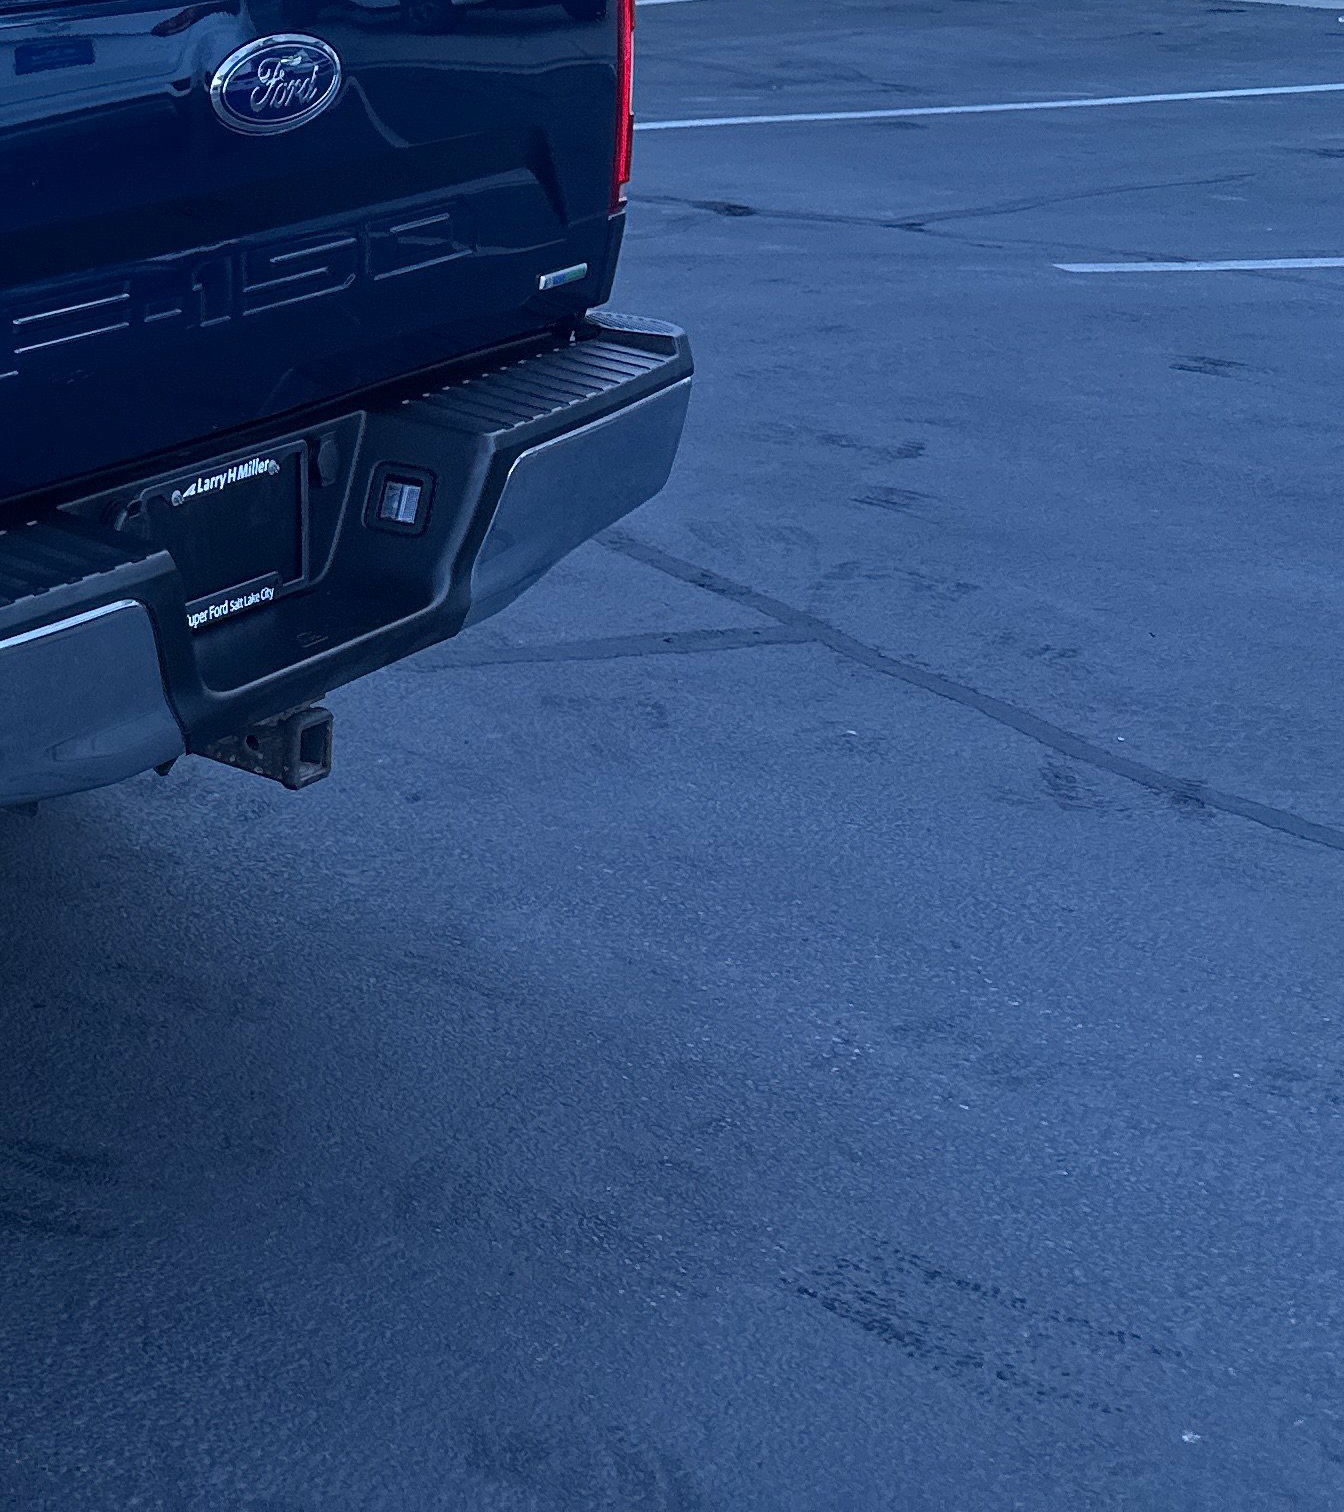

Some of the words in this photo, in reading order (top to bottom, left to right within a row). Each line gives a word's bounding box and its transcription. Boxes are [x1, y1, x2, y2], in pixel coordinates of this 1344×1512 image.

[250, 55, 318, 113] Ford
[197, 473, 227, 490] Larry
[227, 466, 238, 484] H
[237, 457, 270, 481] Miller
[186, 609, 209, 628] uper
[208, 599, 229, 620] Ford
[229, 597, 244, 612] Salt
[243, 592, 261, 607] Lake
[260, 586, 275, 600] City
